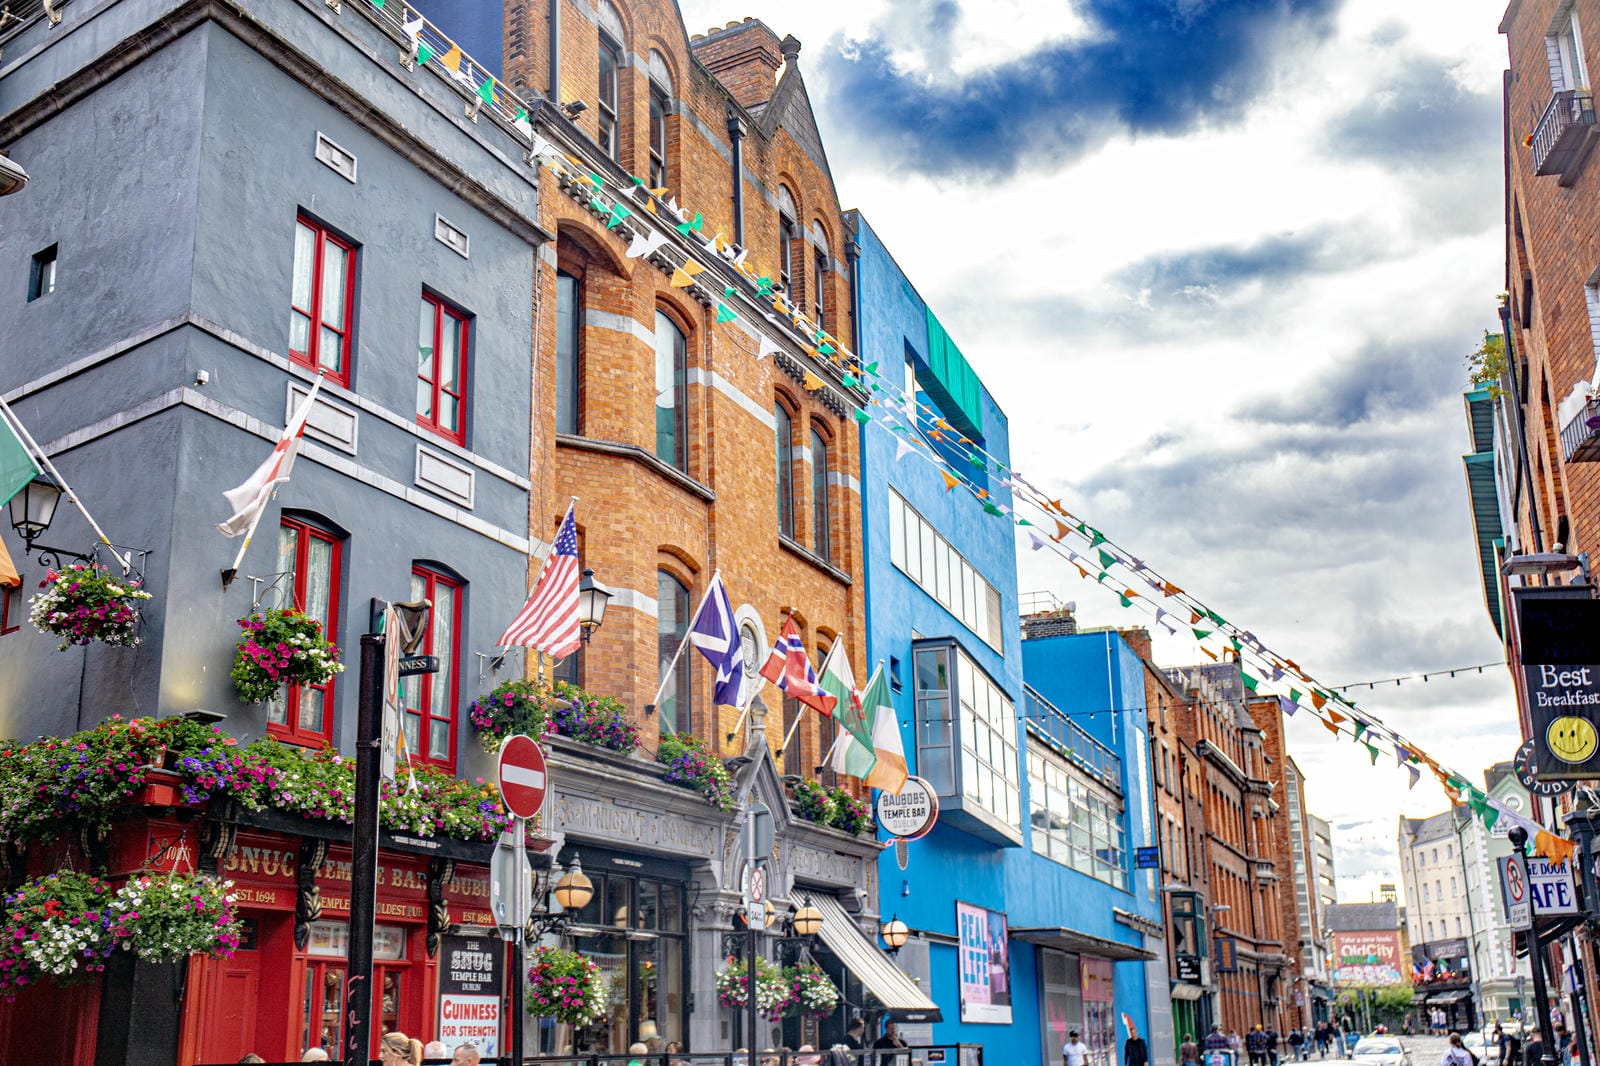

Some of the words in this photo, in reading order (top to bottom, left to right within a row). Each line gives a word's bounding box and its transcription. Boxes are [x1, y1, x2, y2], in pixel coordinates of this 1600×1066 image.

[399, 659, 427, 671] NNESS
[1538, 664, 1593, 688] Best
[1536, 690, 1600, 707] Breakfast
[1523, 776, 1569, 794] STUDI
[884, 809, 911, 819] TEMPLE
[912, 808, 926, 817] BAR
[226, 845, 295, 878] SNUG
[449, 876, 489, 898] DUBL
[1531, 879, 1571, 908] AFÉ
[255, 890, 276, 904] 1694
[320, 896, 350, 911] EMPLE
[376, 902, 407, 916] OLDEST
[407, 905, 423, 917] PUB
[961, 912, 987, 950] REAL
[467, 941, 480, 950] THE
[451, 951, 493, 972] SNUG
[963, 949, 989, 986] LIFE
[451, 971, 477, 982] TEMPLE
[478, 973, 492, 983] BAR
[462, 983, 481, 991] DUBLIN
[442, 999, 497, 1020] GUINNESS
[442, 1026, 456, 1037] FOR
[459, 1026, 497, 1037] STRENGTH
